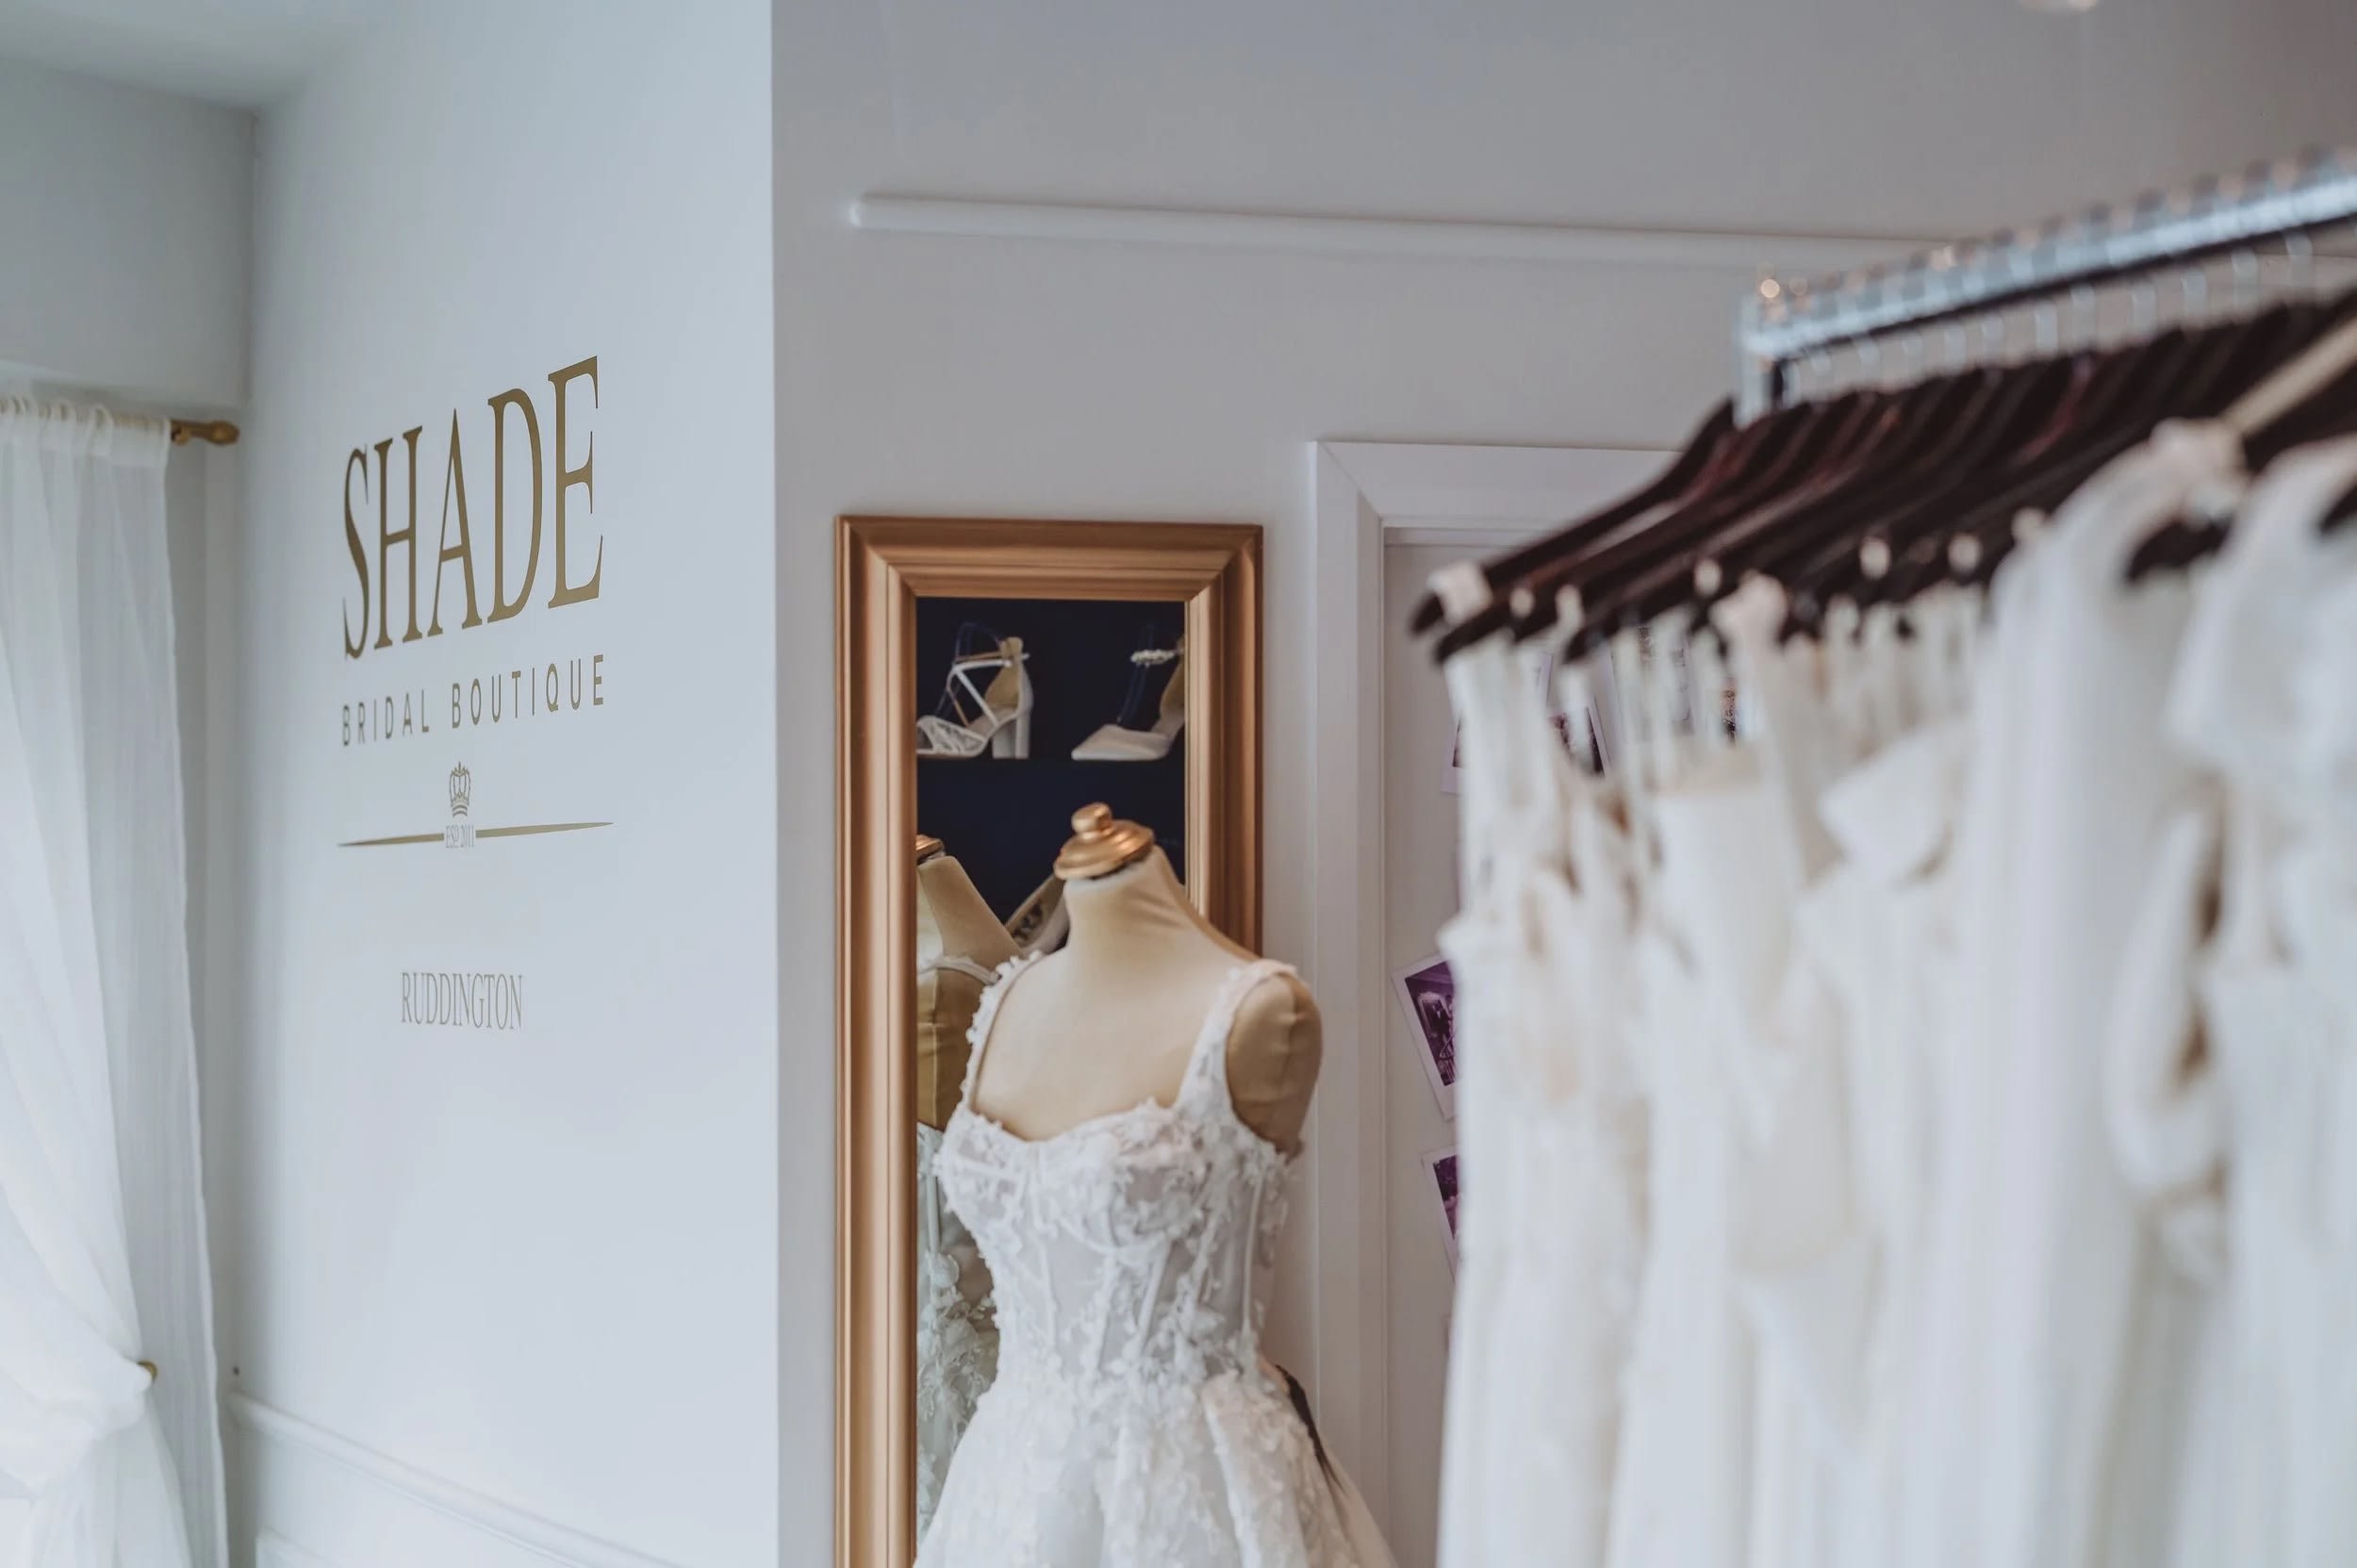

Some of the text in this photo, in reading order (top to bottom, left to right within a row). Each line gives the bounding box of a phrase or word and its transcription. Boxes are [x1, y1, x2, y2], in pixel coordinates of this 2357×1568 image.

[342, 355, 604, 660] SHADE
[341, 654, 604, 748] BRIDAL BOUTIQUE
[401, 971, 523, 1032] RUDDINGTON
